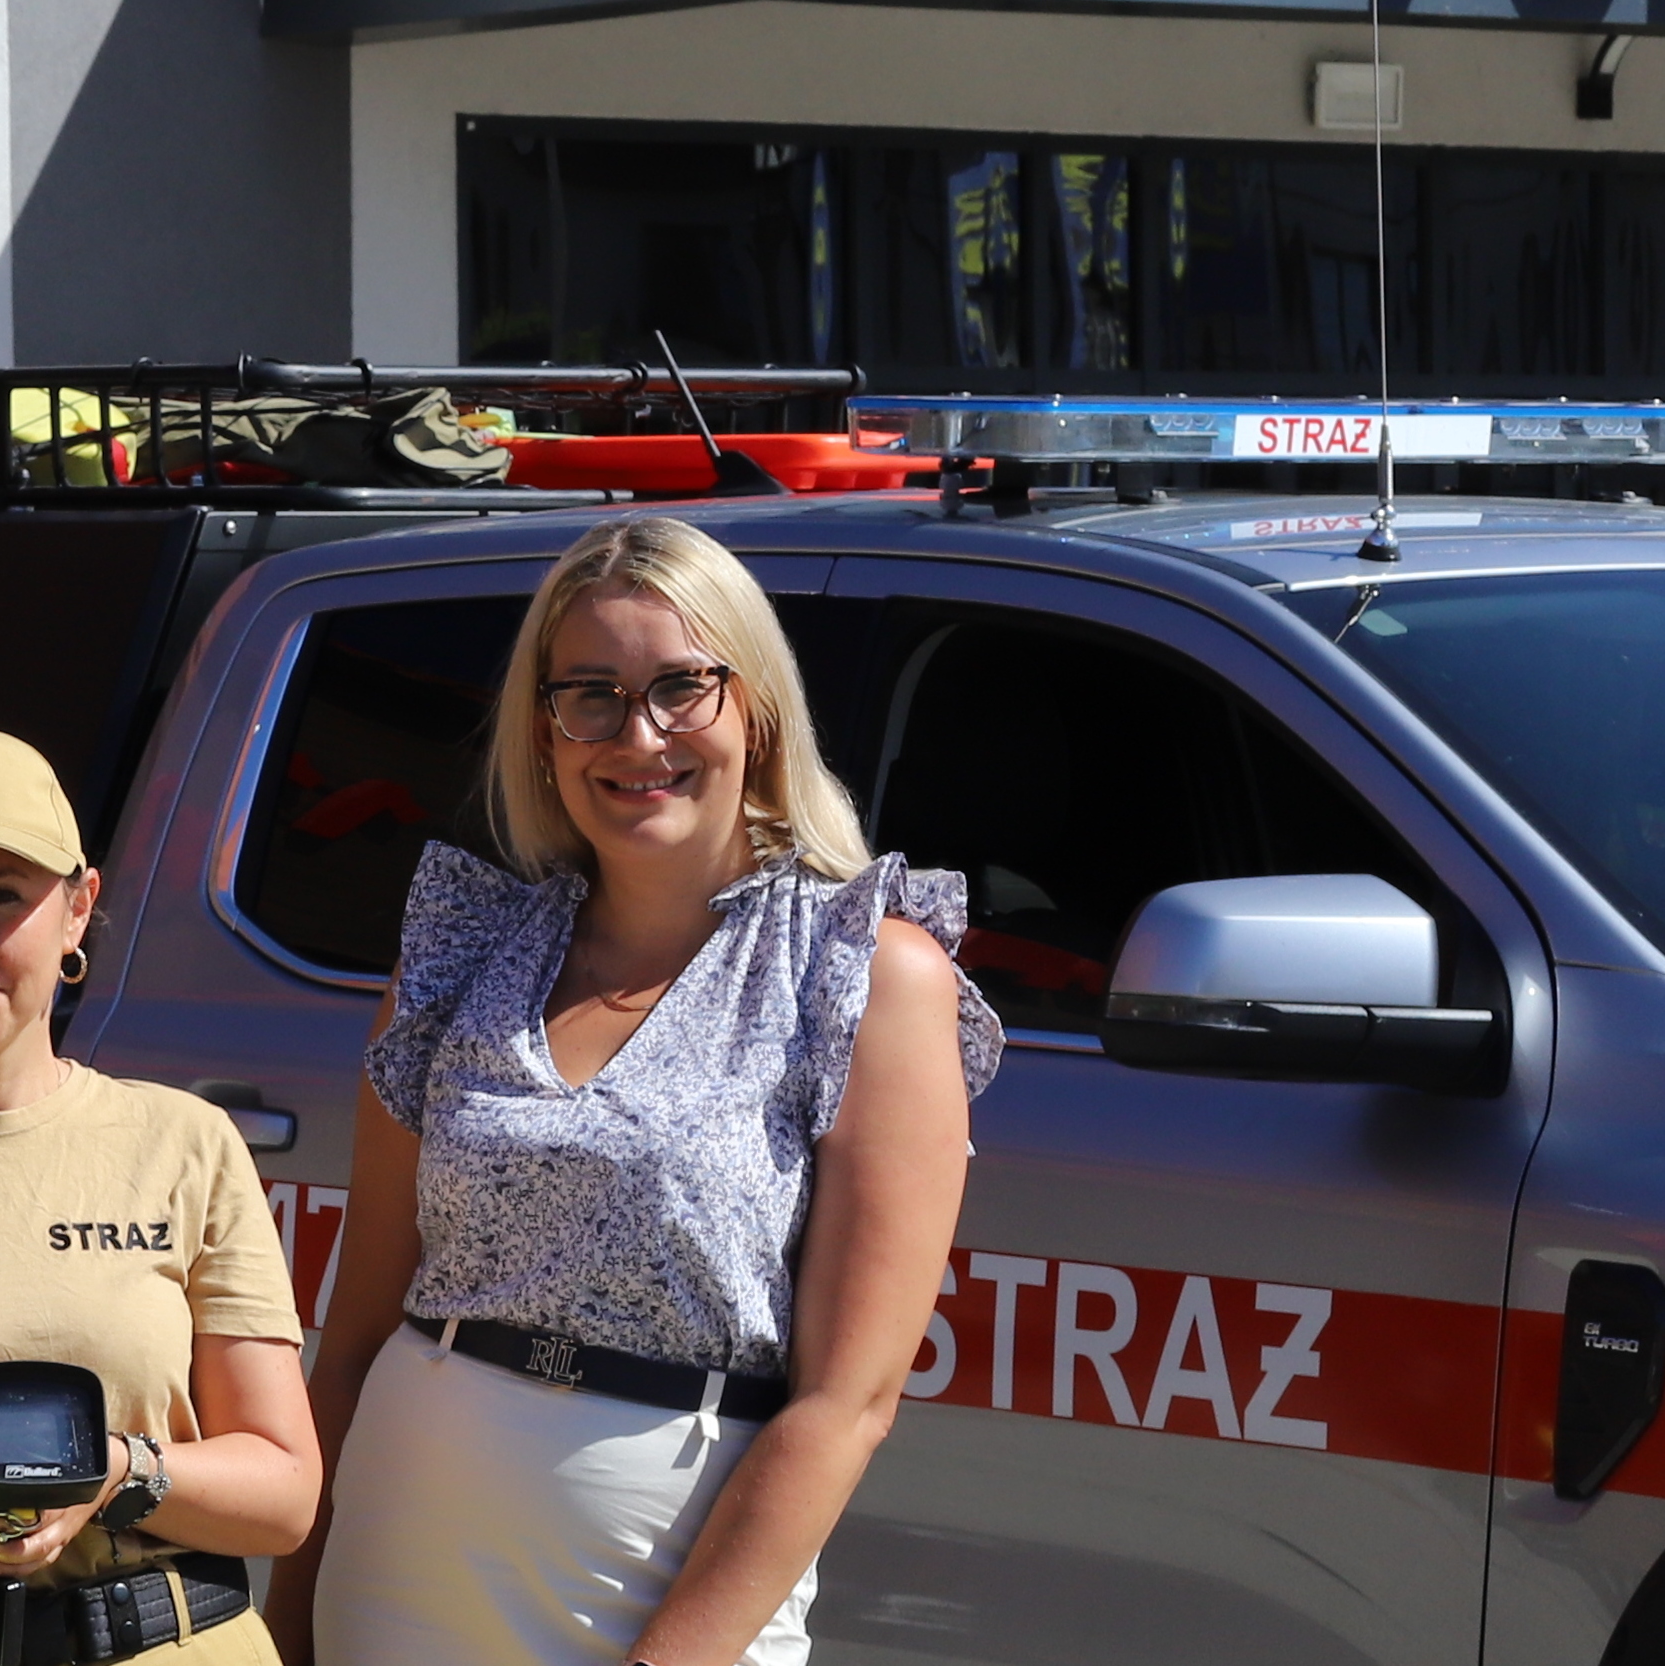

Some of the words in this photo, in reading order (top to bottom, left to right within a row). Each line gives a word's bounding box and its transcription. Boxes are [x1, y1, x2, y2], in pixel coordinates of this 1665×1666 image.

[1258, 417, 1372, 454] STRAŻ
[49, 1222, 172, 1251] STRAŻ
[900, 1251, 1333, 1450] STRAŻ
[1583, 1336, 1639, 1353] TURBO
